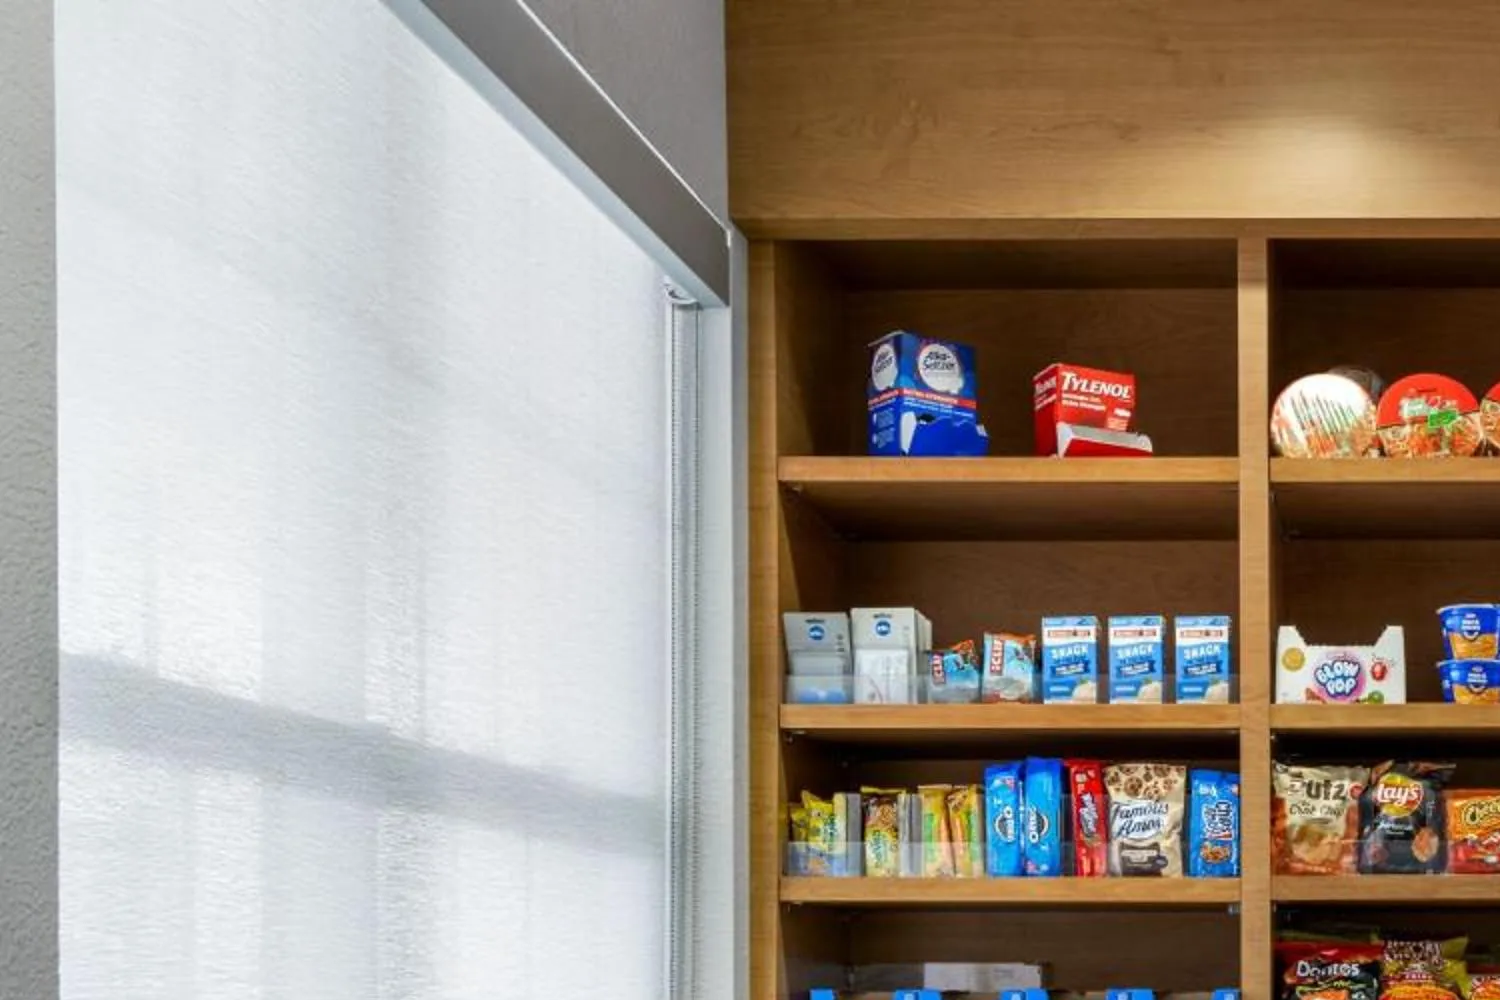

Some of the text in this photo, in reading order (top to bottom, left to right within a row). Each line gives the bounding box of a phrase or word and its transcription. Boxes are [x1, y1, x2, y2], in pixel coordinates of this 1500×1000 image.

[1061, 371, 1131, 399] TYLENOL
[1316, 661, 1359, 685] BLOW
[1326, 678, 1356, 696] POP
[1375, 782, 1421, 806] Lay's
[1112, 802, 1169, 820] Famous
[1116, 817, 1163, 838] Amos
[1297, 960, 1361, 977] Doritos
